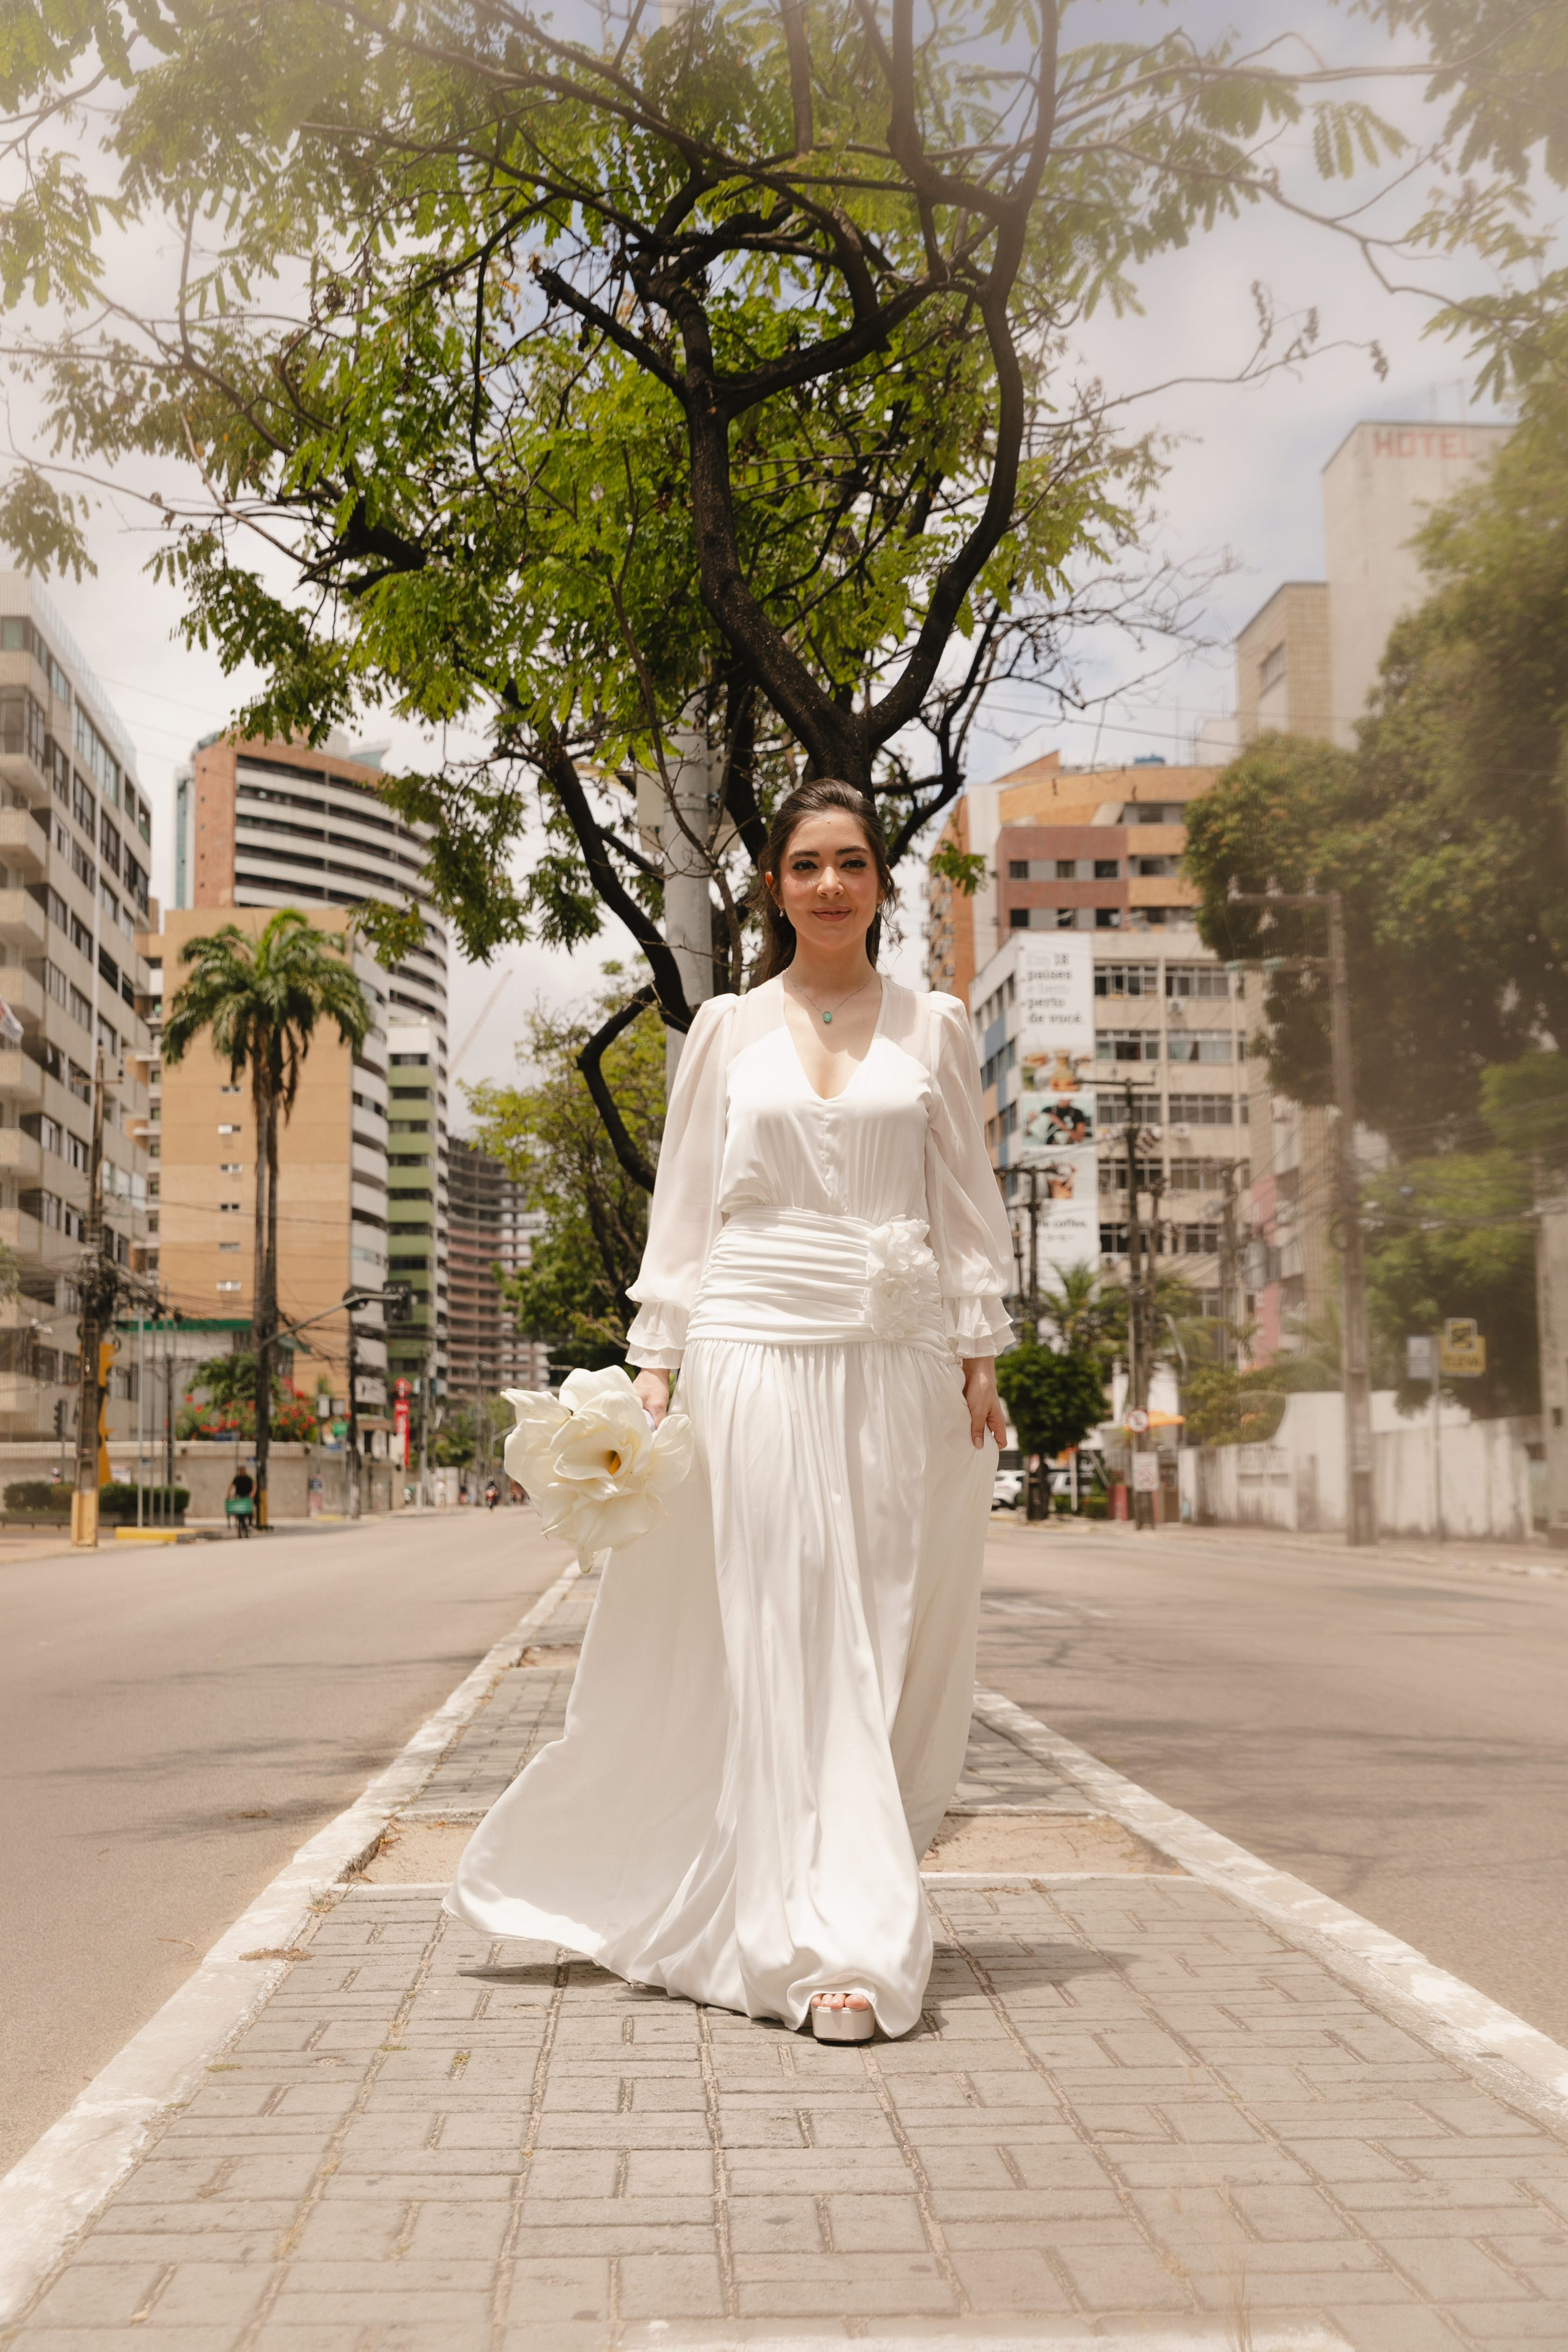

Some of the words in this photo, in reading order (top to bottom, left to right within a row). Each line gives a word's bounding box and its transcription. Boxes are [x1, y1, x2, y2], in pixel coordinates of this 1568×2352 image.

[1373, 432, 1477, 459] HOTEL
[1027, 969, 1071, 982] países
[1028, 998, 1065, 1010] perto
[1028, 1012, 1044, 1024] de
